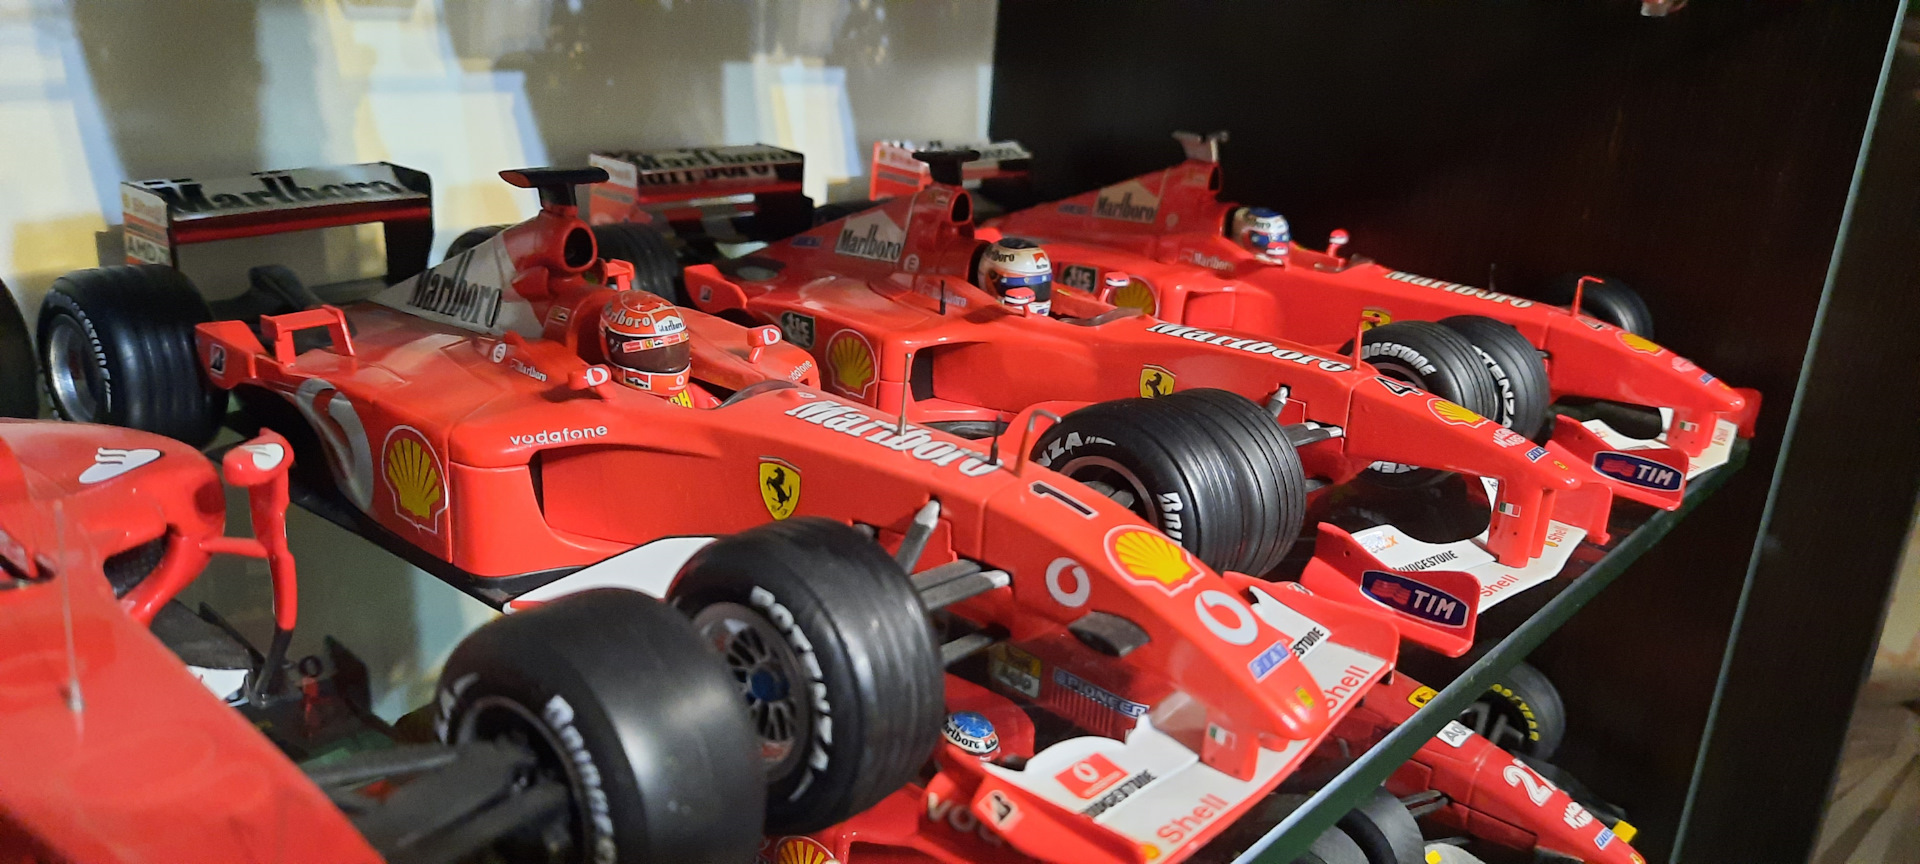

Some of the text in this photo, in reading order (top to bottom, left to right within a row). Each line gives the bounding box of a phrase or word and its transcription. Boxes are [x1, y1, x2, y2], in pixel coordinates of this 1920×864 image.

[1097, 192, 1156, 222] Marlboro
[841, 224, 901, 260] Marlboro
[1192, 251, 1235, 272] Marlboro
[407, 249, 502, 328] Marlboro
[1384, 270, 1534, 309] Marlboro
[1146, 321, 1353, 373] Marlboro
[1376, 376, 1424, 396] 4
[509, 424, 609, 447] vodafone
[784, 401, 1003, 477] Marlboro
[1636, 463, 1676, 487] TIM
[1030, 481, 1097, 518] 1
[1479, 573, 1520, 598] Shell
[1412, 588, 1458, 620] TIM
[1249, 642, 1292, 680] FIAT
[1156, 793, 1230, 846] Shell
